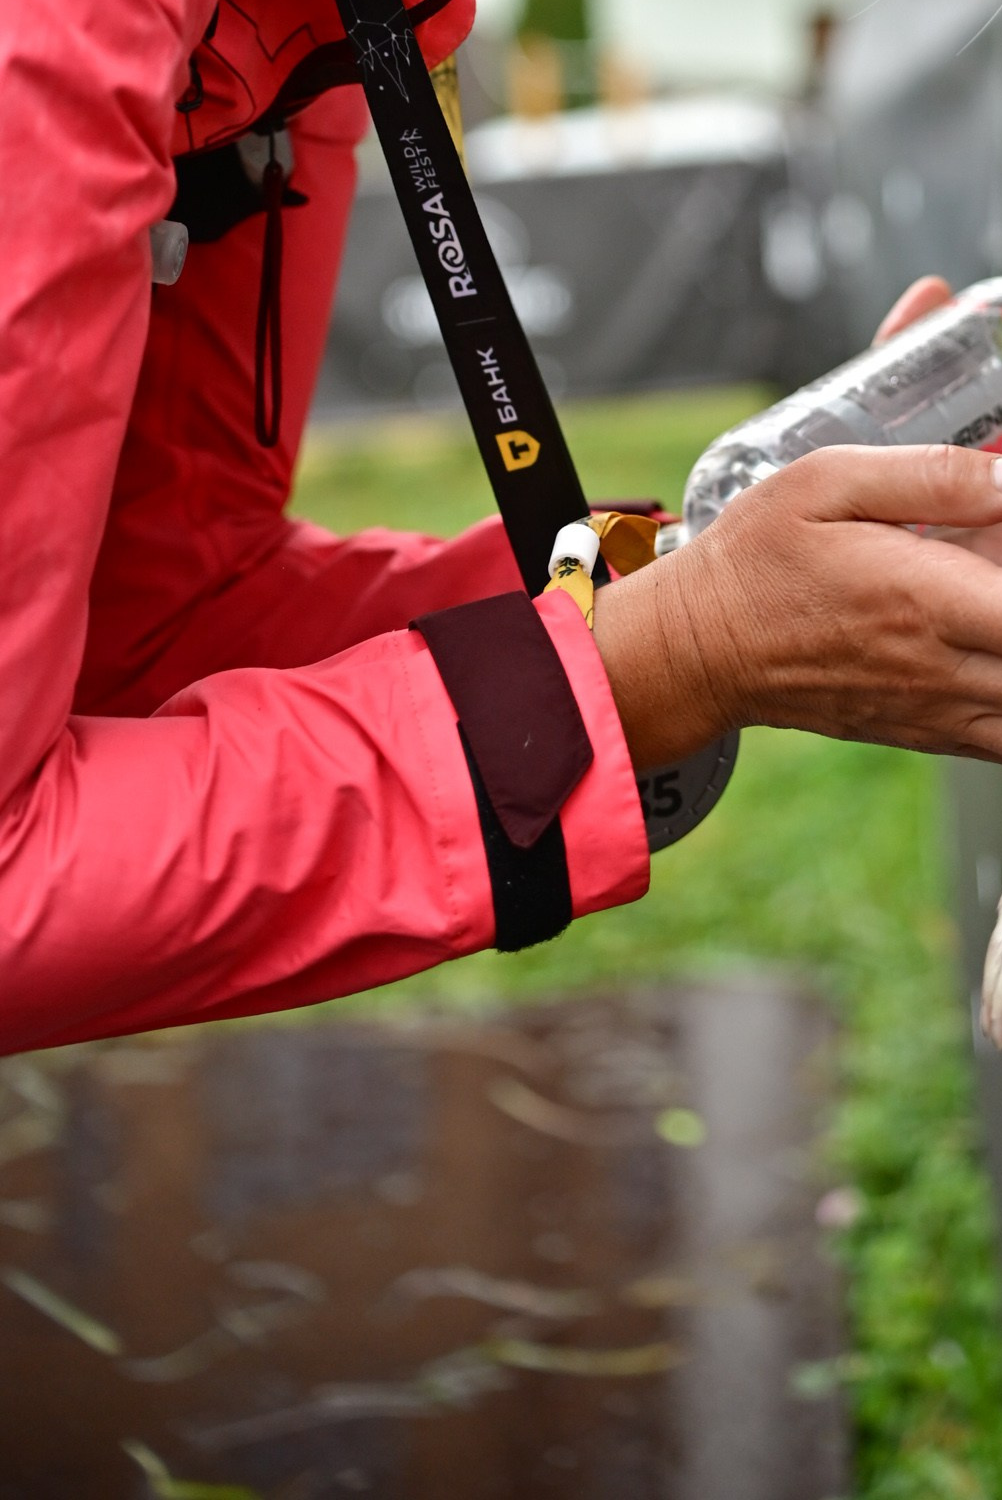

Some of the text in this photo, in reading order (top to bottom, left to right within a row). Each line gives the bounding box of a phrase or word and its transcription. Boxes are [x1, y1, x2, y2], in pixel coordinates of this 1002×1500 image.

[403, 146, 427, 192] WILD
[415, 146, 440, 189] FEST
[421, 191, 478, 299] ROSA
[476, 346, 518, 424] БАНК
